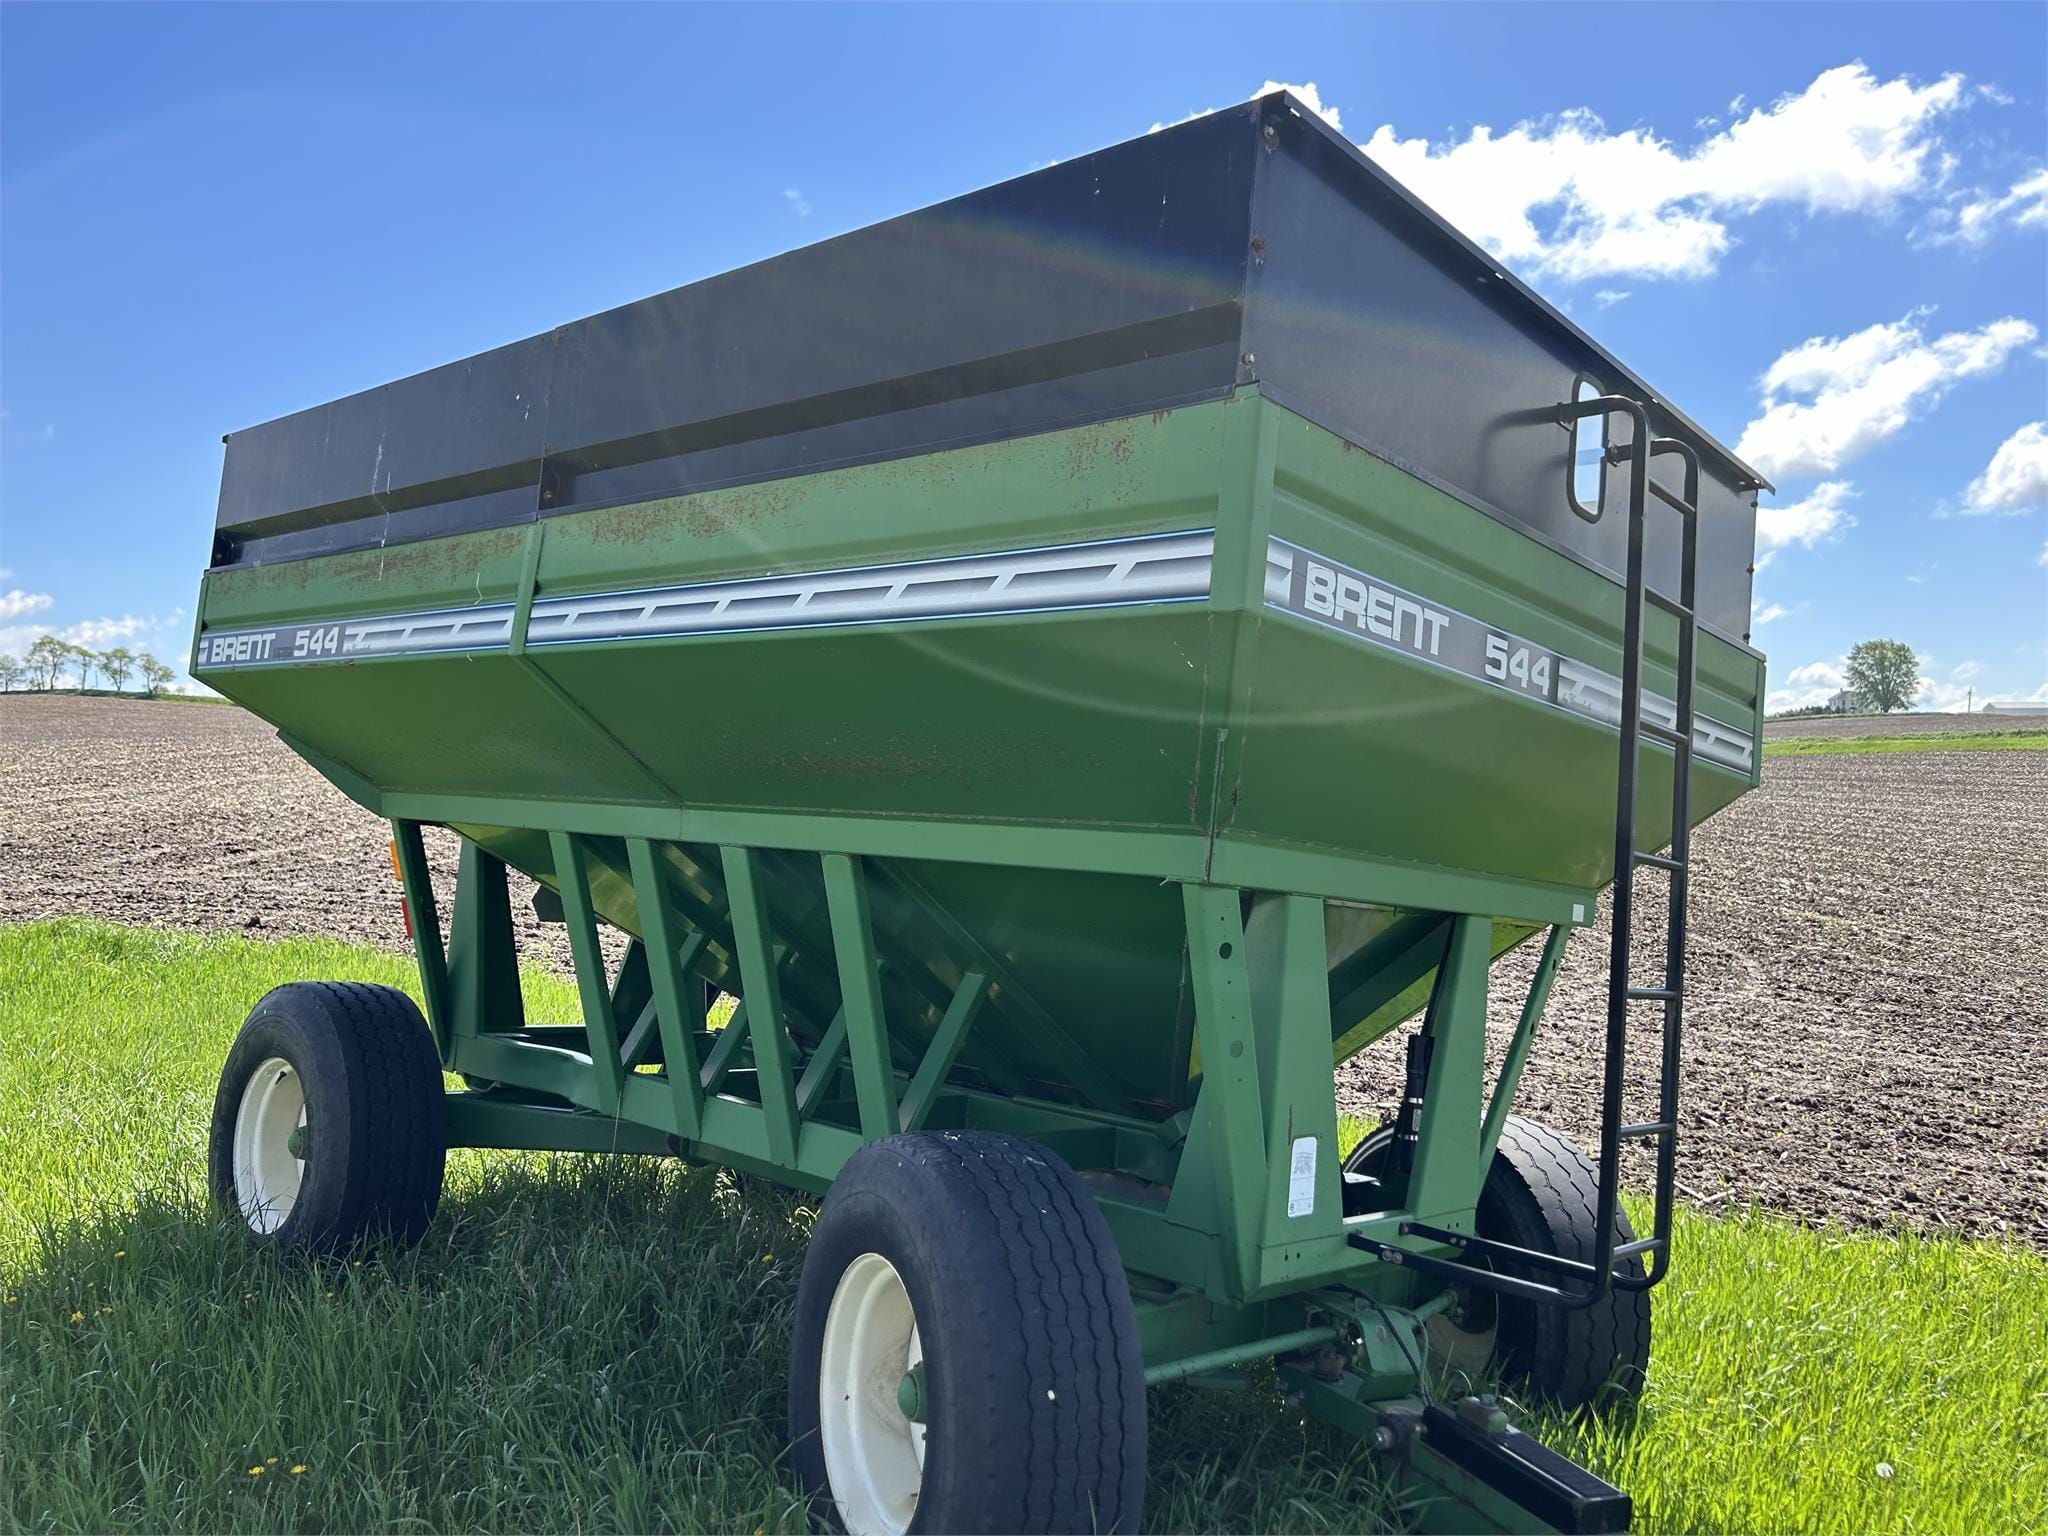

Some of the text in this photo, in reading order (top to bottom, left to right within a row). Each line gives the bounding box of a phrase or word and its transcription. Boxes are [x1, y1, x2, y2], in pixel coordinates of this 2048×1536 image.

[211, 627, 340, 663] BRENT 544
[1304, 561, 1551, 696] BRENT 544
